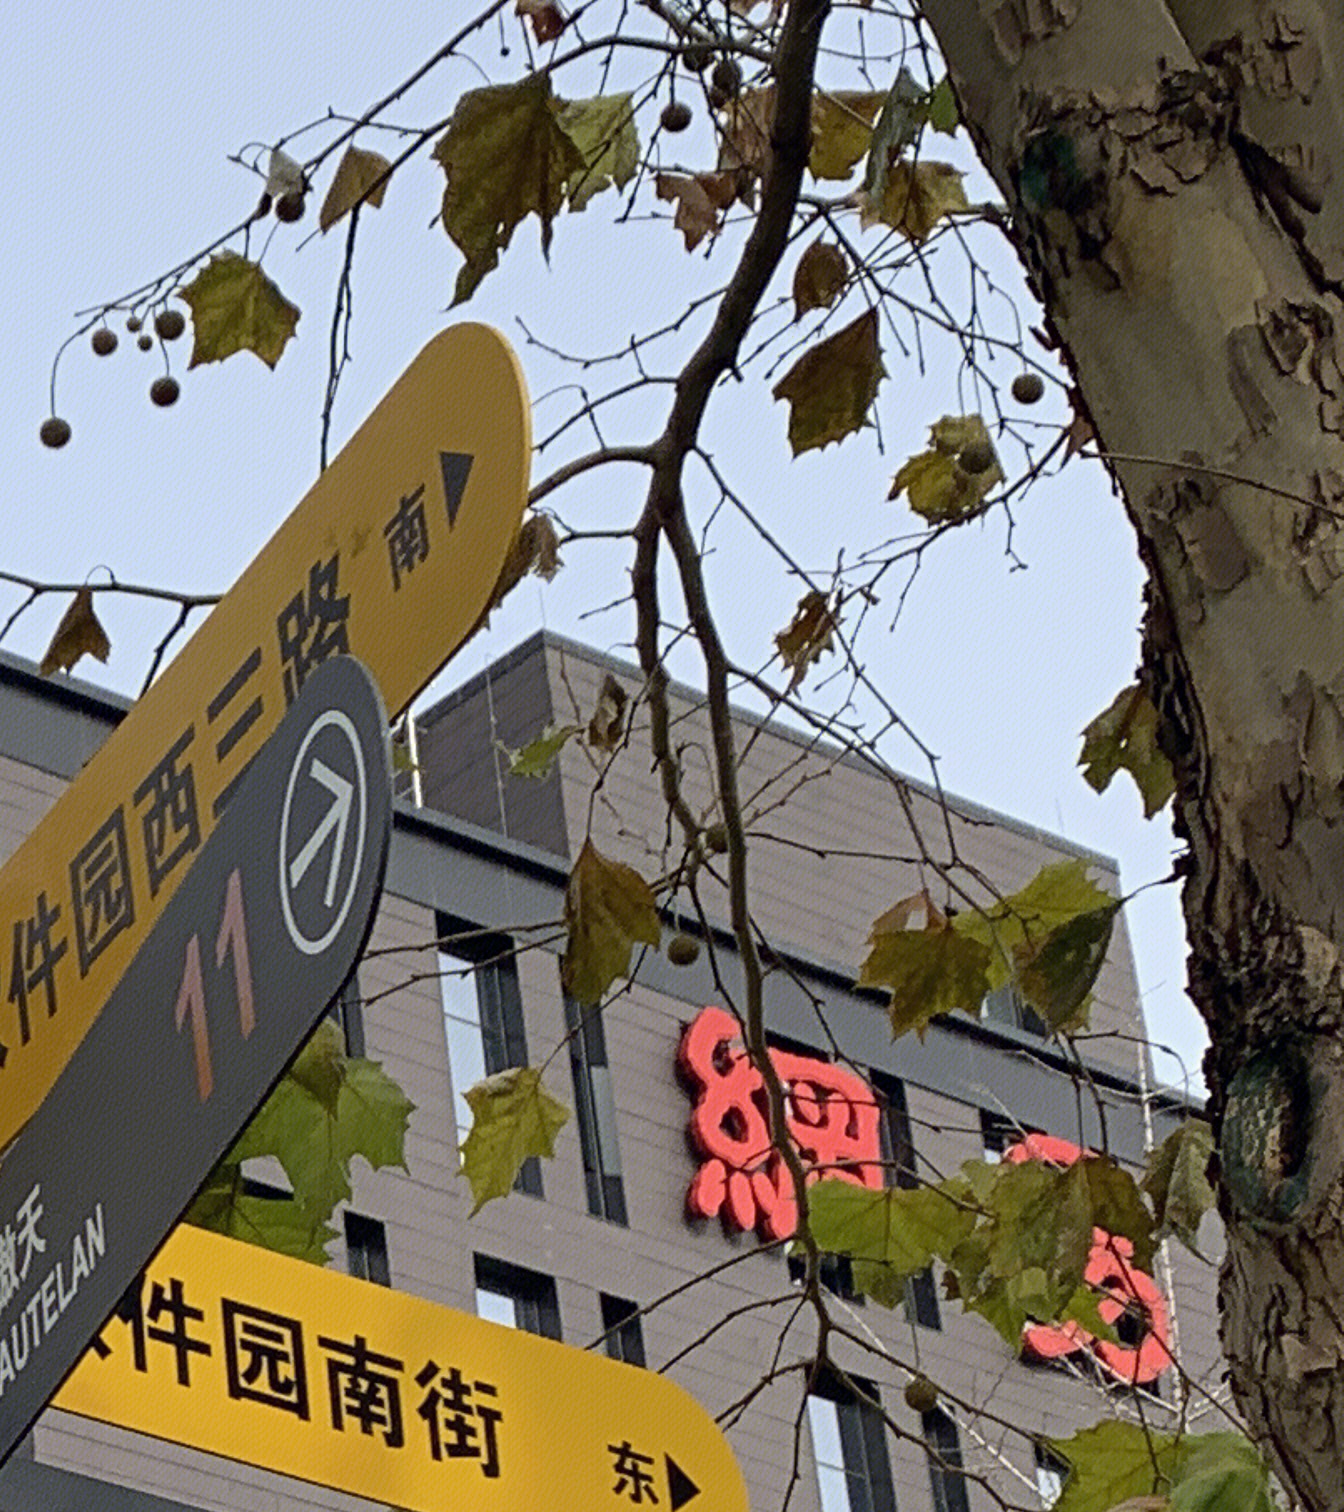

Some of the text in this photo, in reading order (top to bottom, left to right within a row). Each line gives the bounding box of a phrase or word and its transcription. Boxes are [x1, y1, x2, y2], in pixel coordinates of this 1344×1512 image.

[383, 485, 428, 592] 南
[175, 868, 256, 1102] 11
[85, 1273, 660, 1506] 件园南街 东
